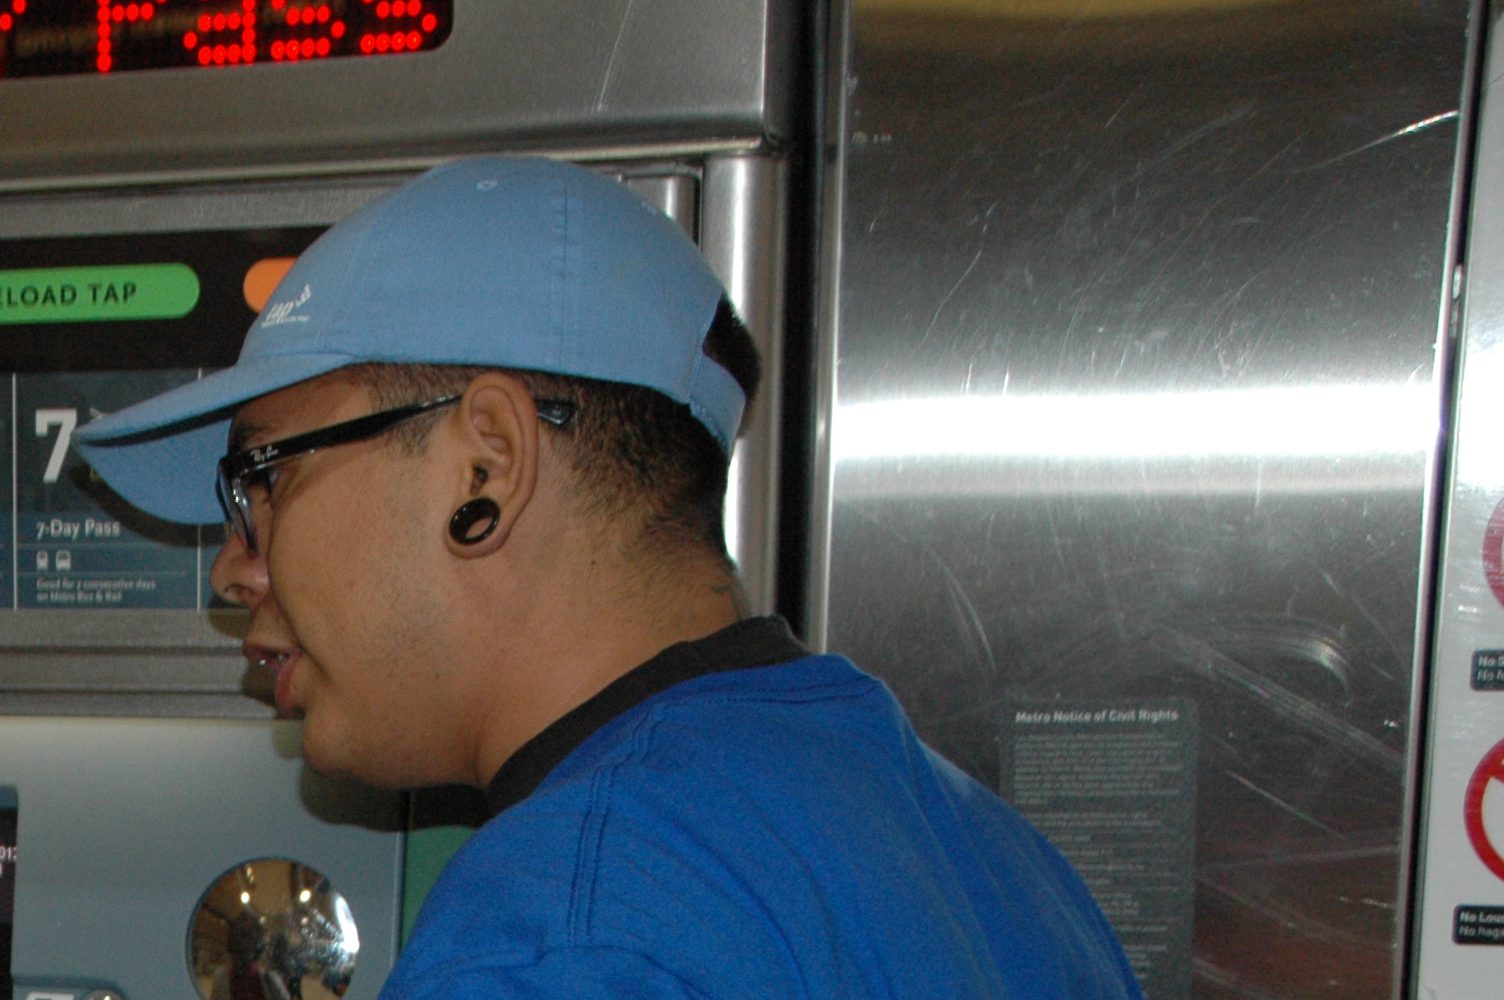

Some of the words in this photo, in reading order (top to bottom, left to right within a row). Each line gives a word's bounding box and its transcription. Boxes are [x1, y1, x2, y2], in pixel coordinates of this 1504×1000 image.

[88, 281, 137, 305] TAP
[35, 408, 78, 483] 7
[36, 519, 80, 542] 7-Day
[85, 519, 121, 537] Pass
[1478, 655, 1494, 667] No
[1015, 711, 1050, 723] Metro
[1053, 710, 1092, 723] Notice
[1138, 709, 1179, 724] Rights
[1460, 911, 1477, 923] No
